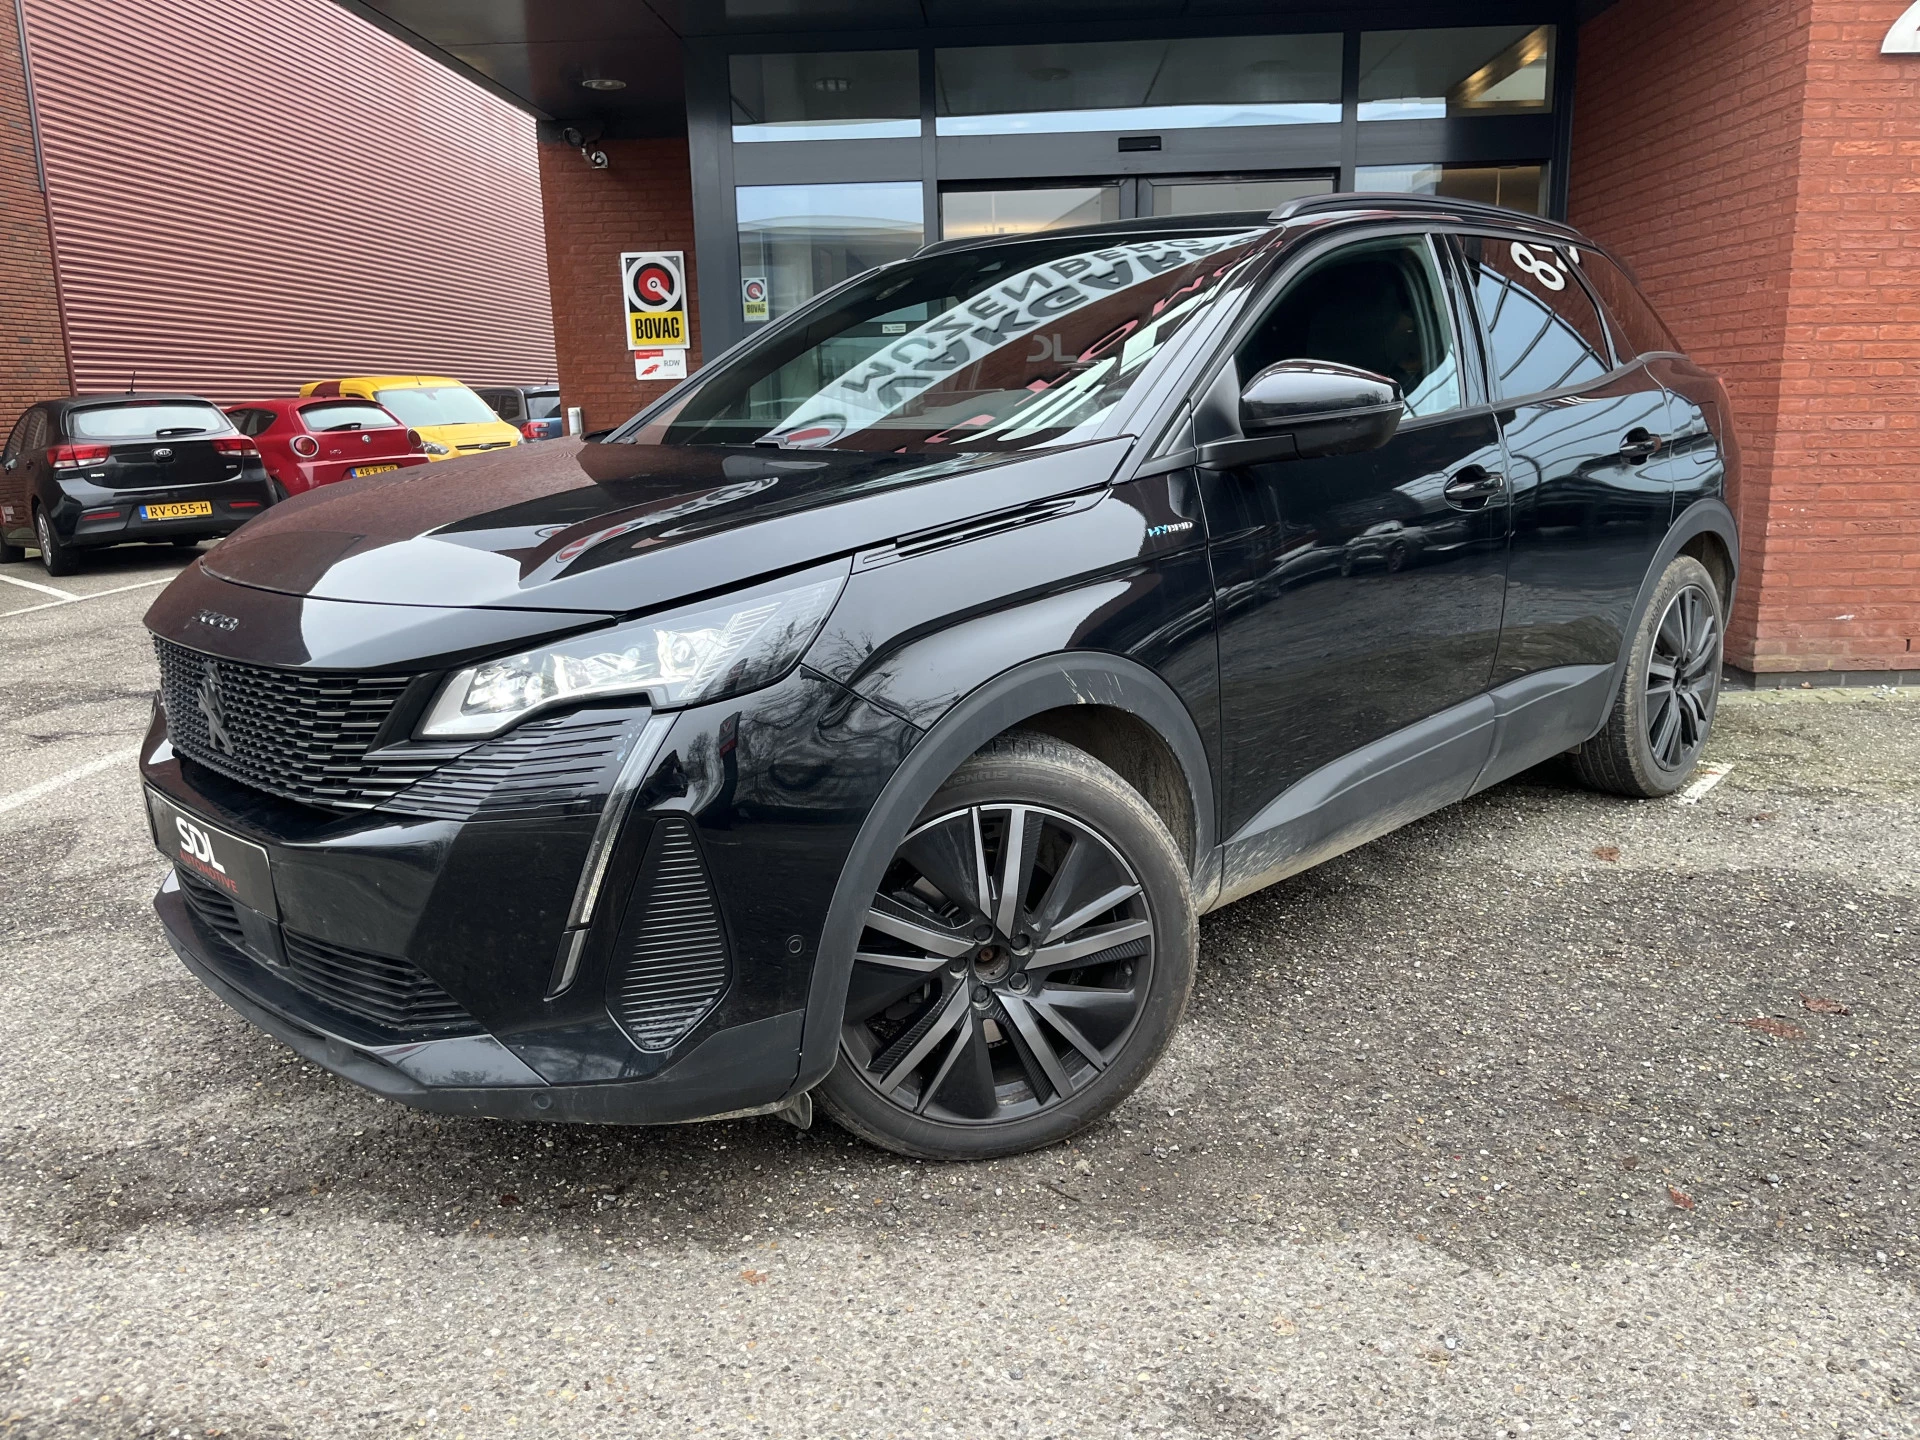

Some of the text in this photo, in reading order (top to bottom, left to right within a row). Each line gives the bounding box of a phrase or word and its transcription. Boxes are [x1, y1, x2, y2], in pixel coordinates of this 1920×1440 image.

[746, 304, 765, 314] BOVAG
[635, 316, 680, 340] BOVAG
[663, 359, 681, 367] RDW
[150, 503, 209, 518] RV-055-H
[1147, 521, 1193, 538] HYBRID
[175, 816, 226, 874] SDL
[179, 848, 239, 894] AUTOMOTIVE
